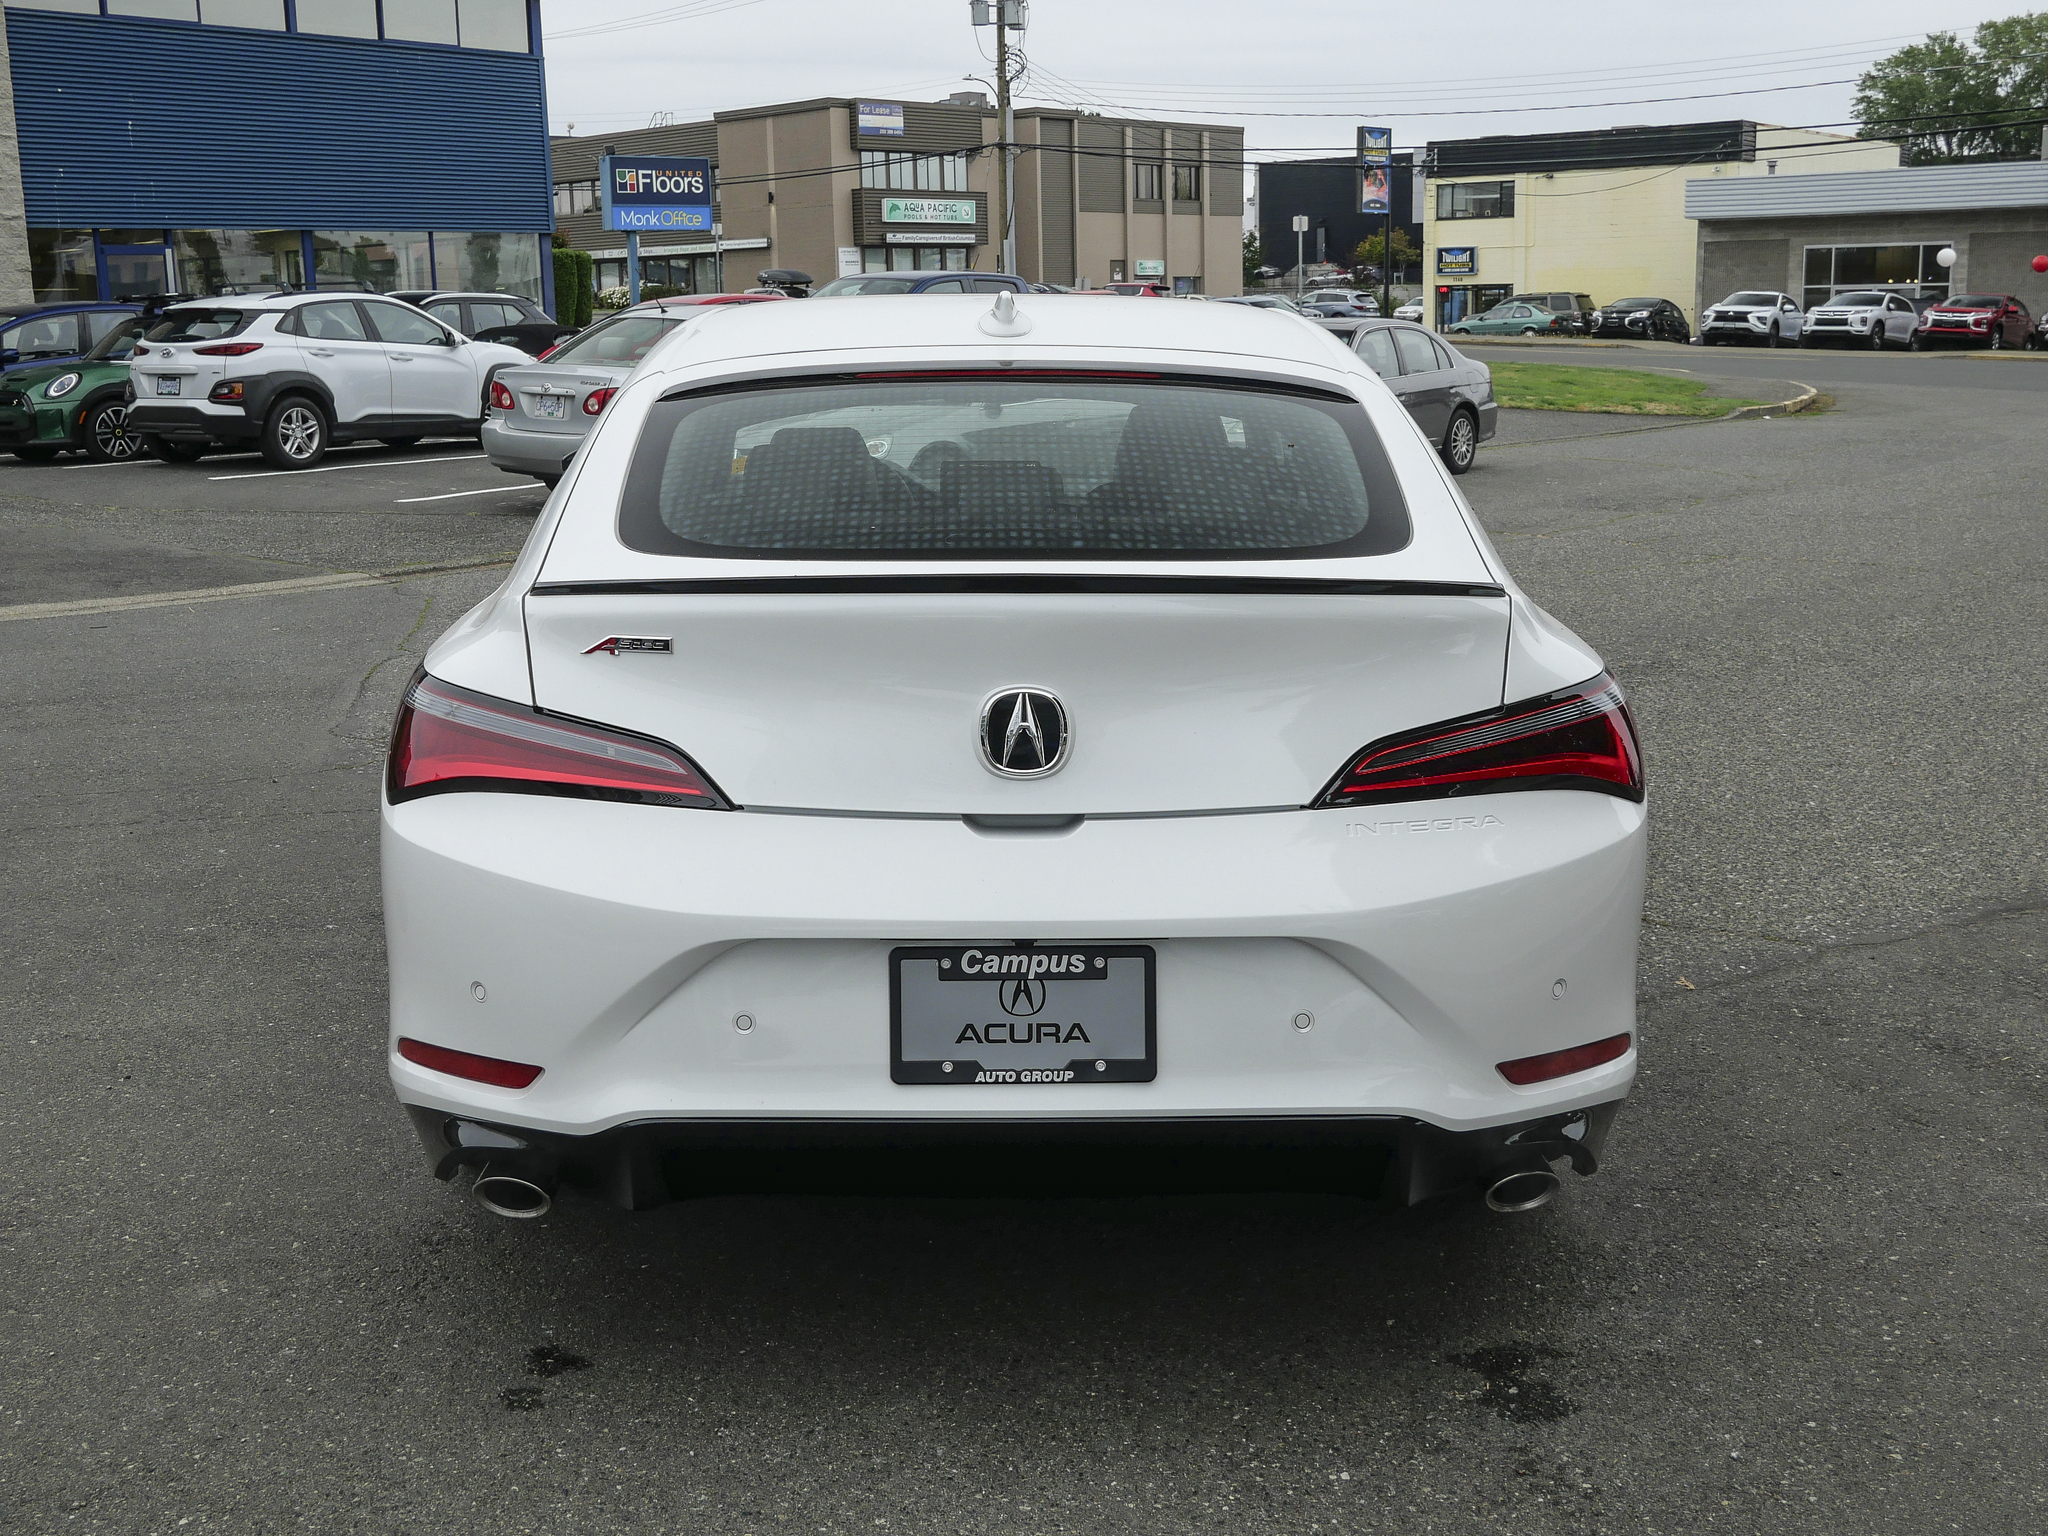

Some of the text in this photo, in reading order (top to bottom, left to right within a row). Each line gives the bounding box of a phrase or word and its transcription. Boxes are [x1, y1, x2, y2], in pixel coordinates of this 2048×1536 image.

[860, 104, 871, 113] For
[872, 106, 890, 115] Lease
[1365, 132, 1388, 148] TWILIGHT
[638, 170, 704, 194] Floors
[904, 202, 957, 213] AQUA PACIFIC
[621, 210, 702, 226] Monk Office
[1442, 250, 1470, 262] TWILIGHT
[1346, 814, 1505, 836] INTEGRA
[961, 950, 1086, 979] Campus
[955, 1022, 1091, 1044] ACURA
[975, 1071, 1074, 1082] AUTO GROUP
